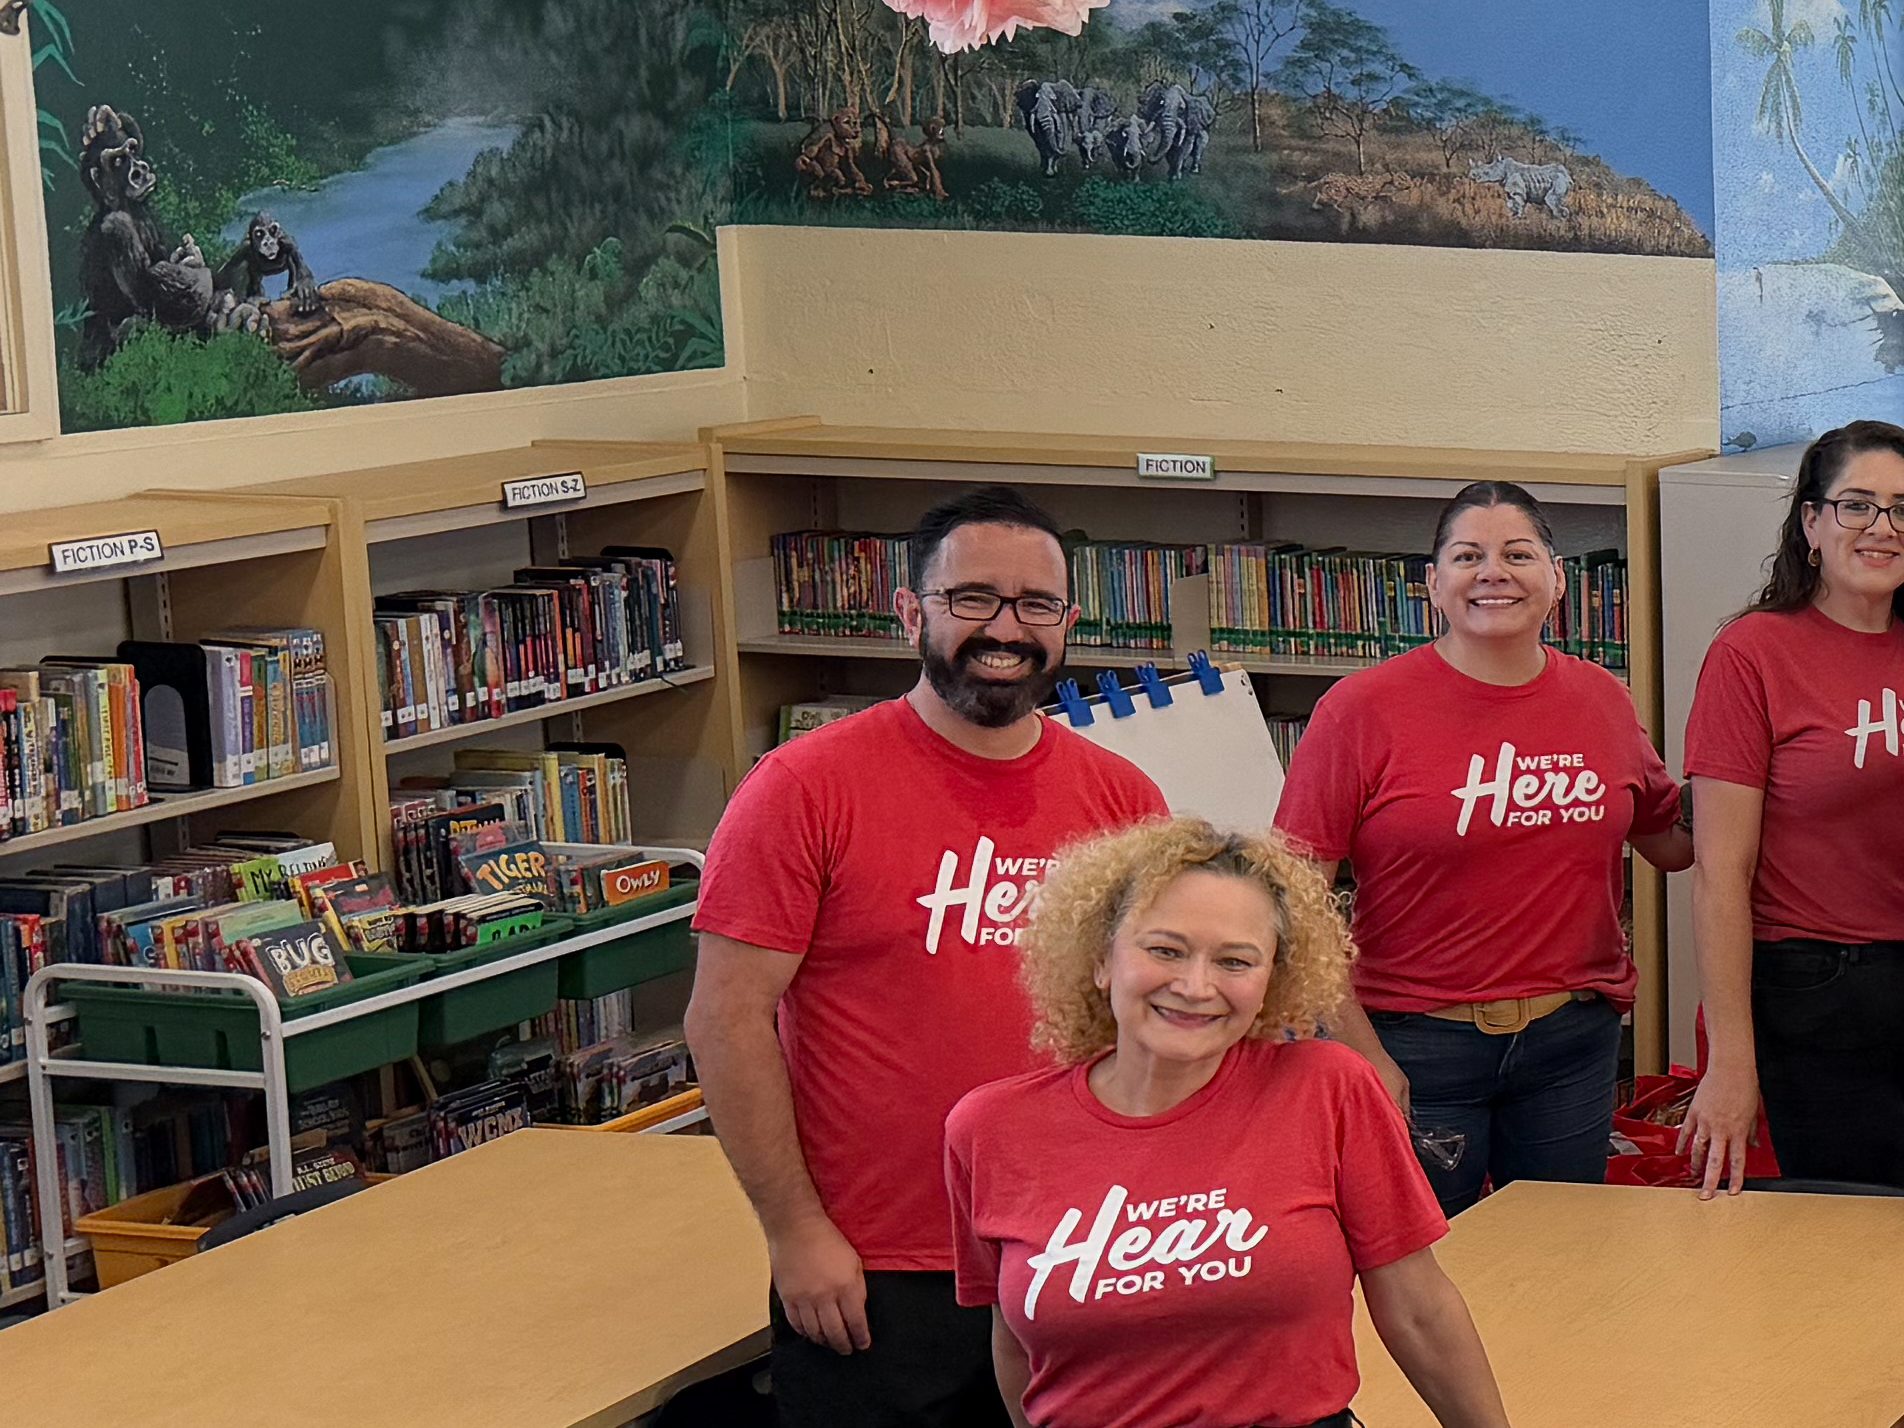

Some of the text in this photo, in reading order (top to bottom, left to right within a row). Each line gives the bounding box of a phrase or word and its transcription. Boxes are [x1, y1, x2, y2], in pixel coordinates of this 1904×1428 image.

[1145, 459, 1206, 473] FICTION
[512, 478, 581, 501] FICTION S-Z
[62, 536, 155, 564] FICTION P-S
[1516, 753, 1584, 771] WE'RE
[1451, 741, 1606, 836] Here
[1507, 805, 1605, 827] FOR YOU
[250, 868, 273, 895] MY
[476, 851, 546, 891] TIGER
[265, 932, 336, 974] BUG
[1127, 1188, 1227, 1222] WE'RE
[1024, 1184, 1269, 1321] Hear
[1095, 1256, 1252, 1300] FOR YOU
